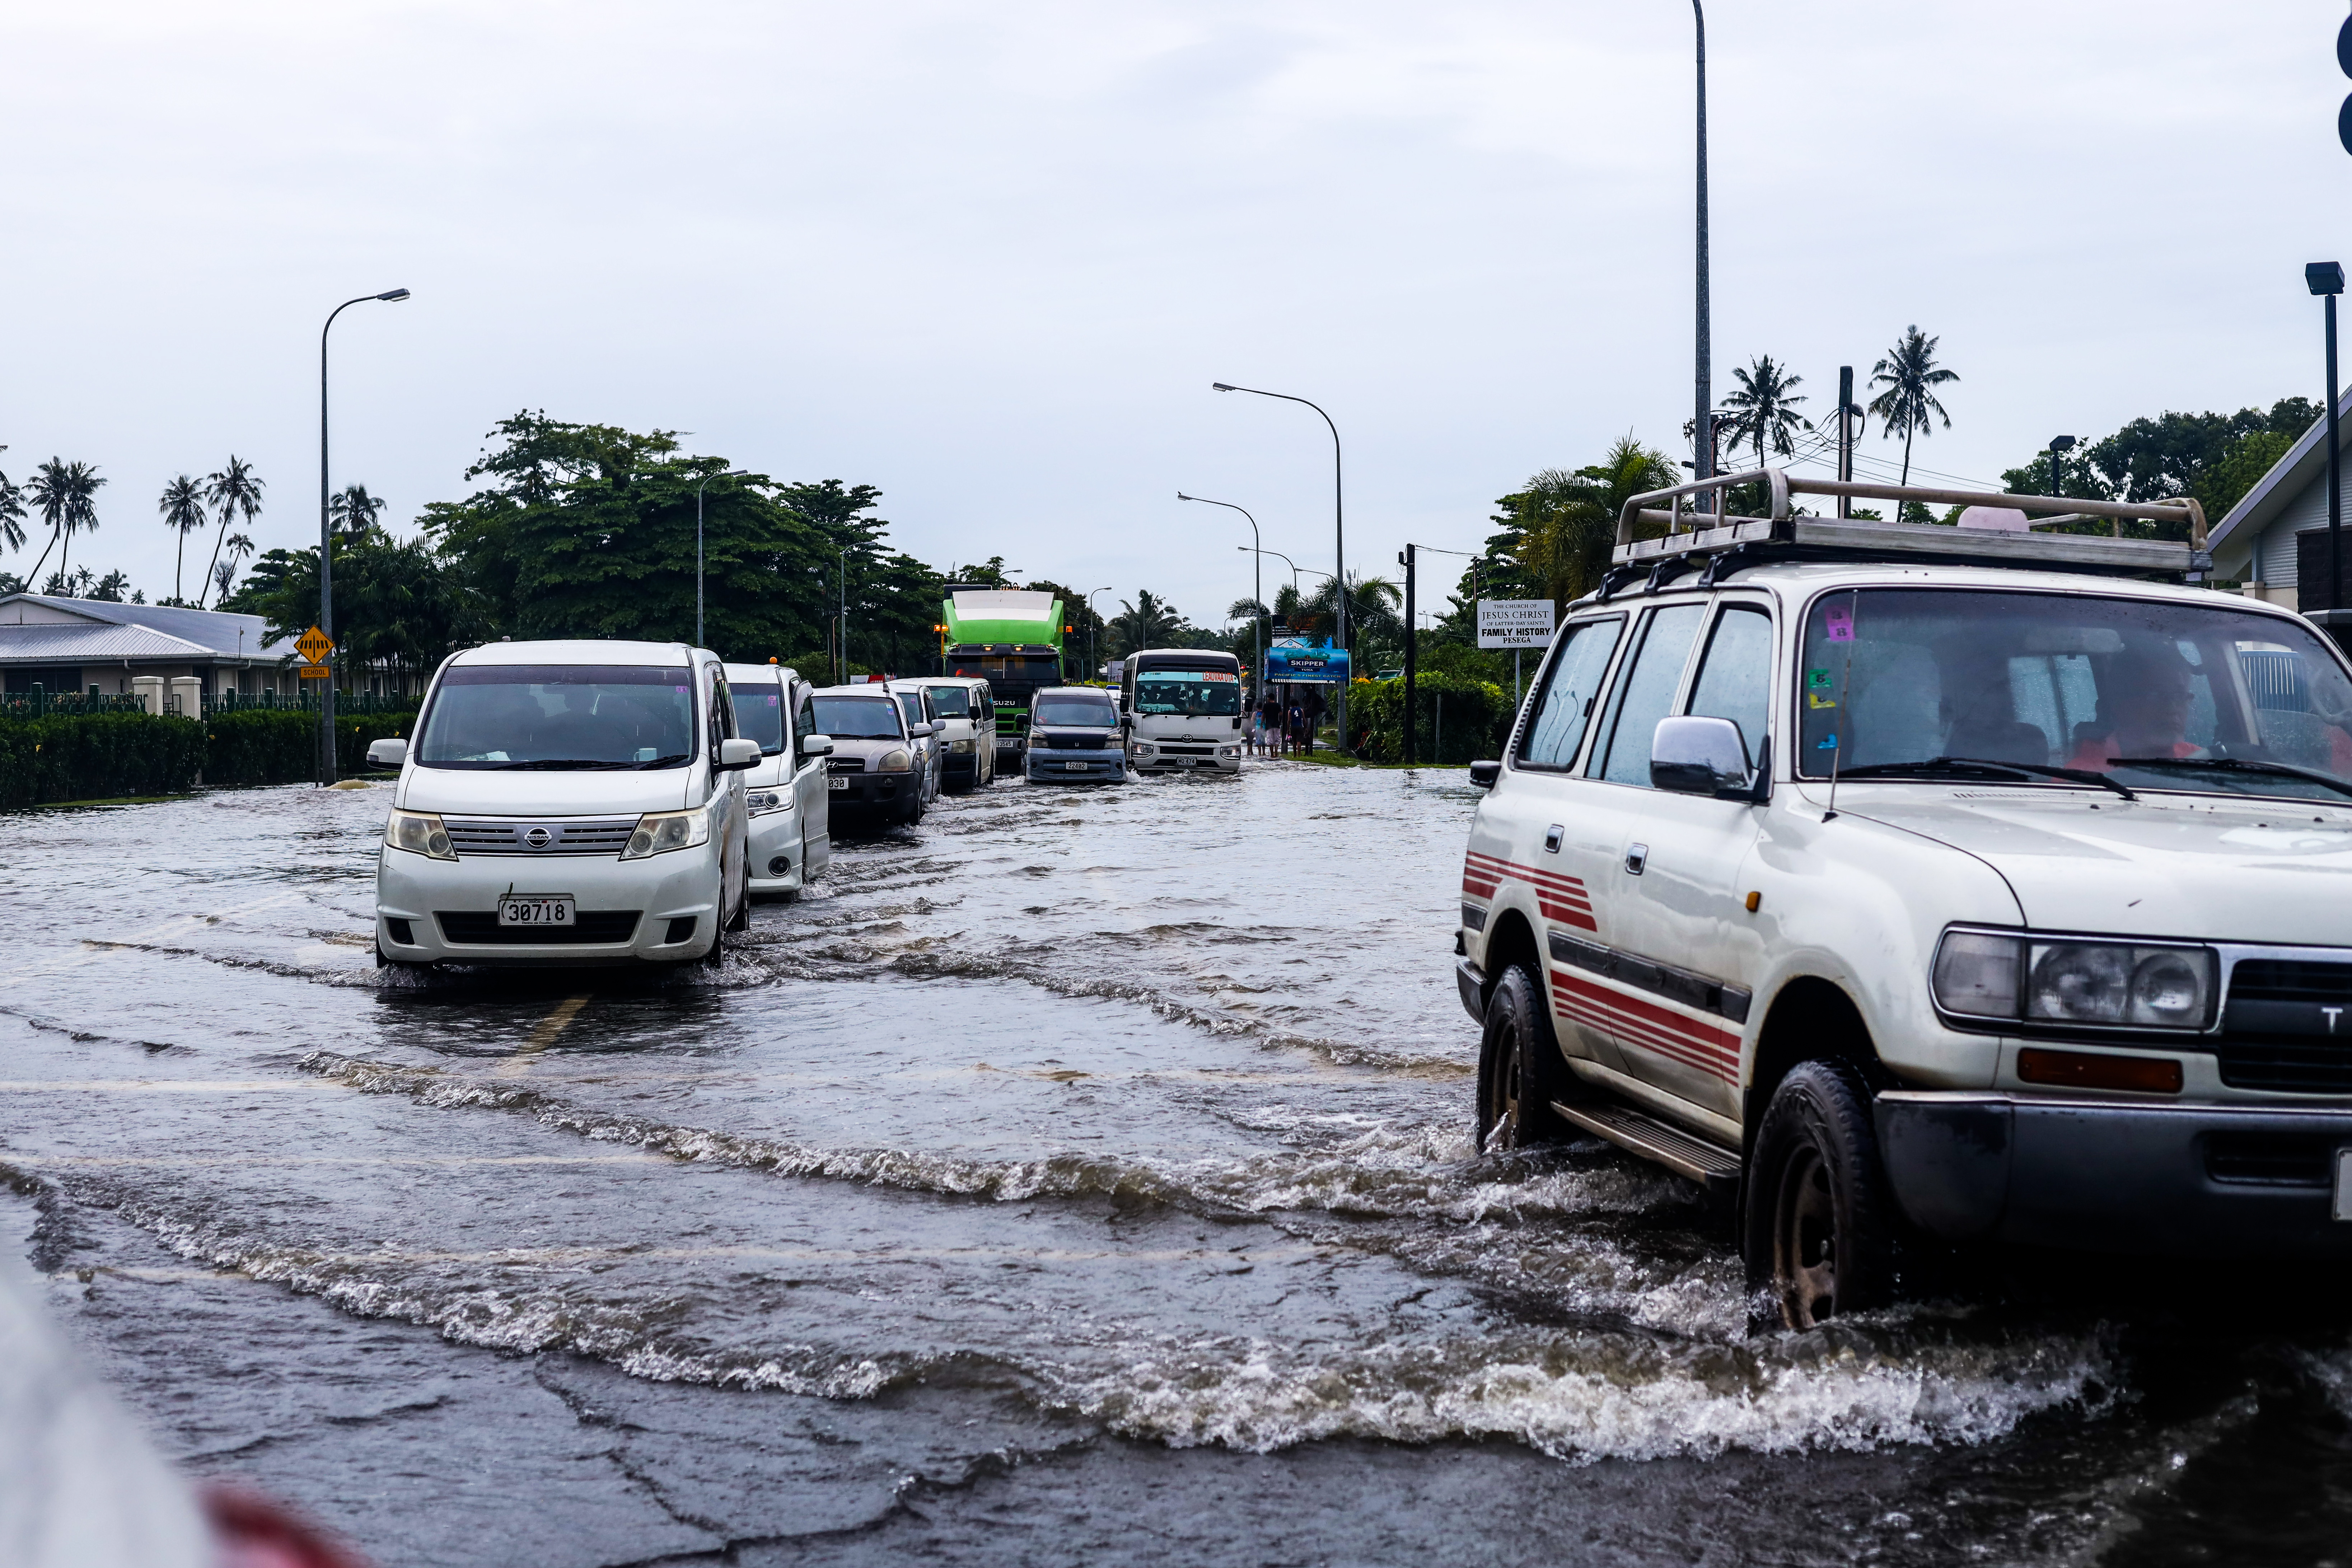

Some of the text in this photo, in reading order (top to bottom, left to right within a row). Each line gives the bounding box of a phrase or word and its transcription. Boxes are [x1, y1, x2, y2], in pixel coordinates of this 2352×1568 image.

[1482, 612, 1509, 621] JESUS
[1482, 627, 1551, 637] FAMILY HISTORY
[1202, 671, 1233, 683] LEAUVAA UTA
[509, 904, 565, 921] 30718
